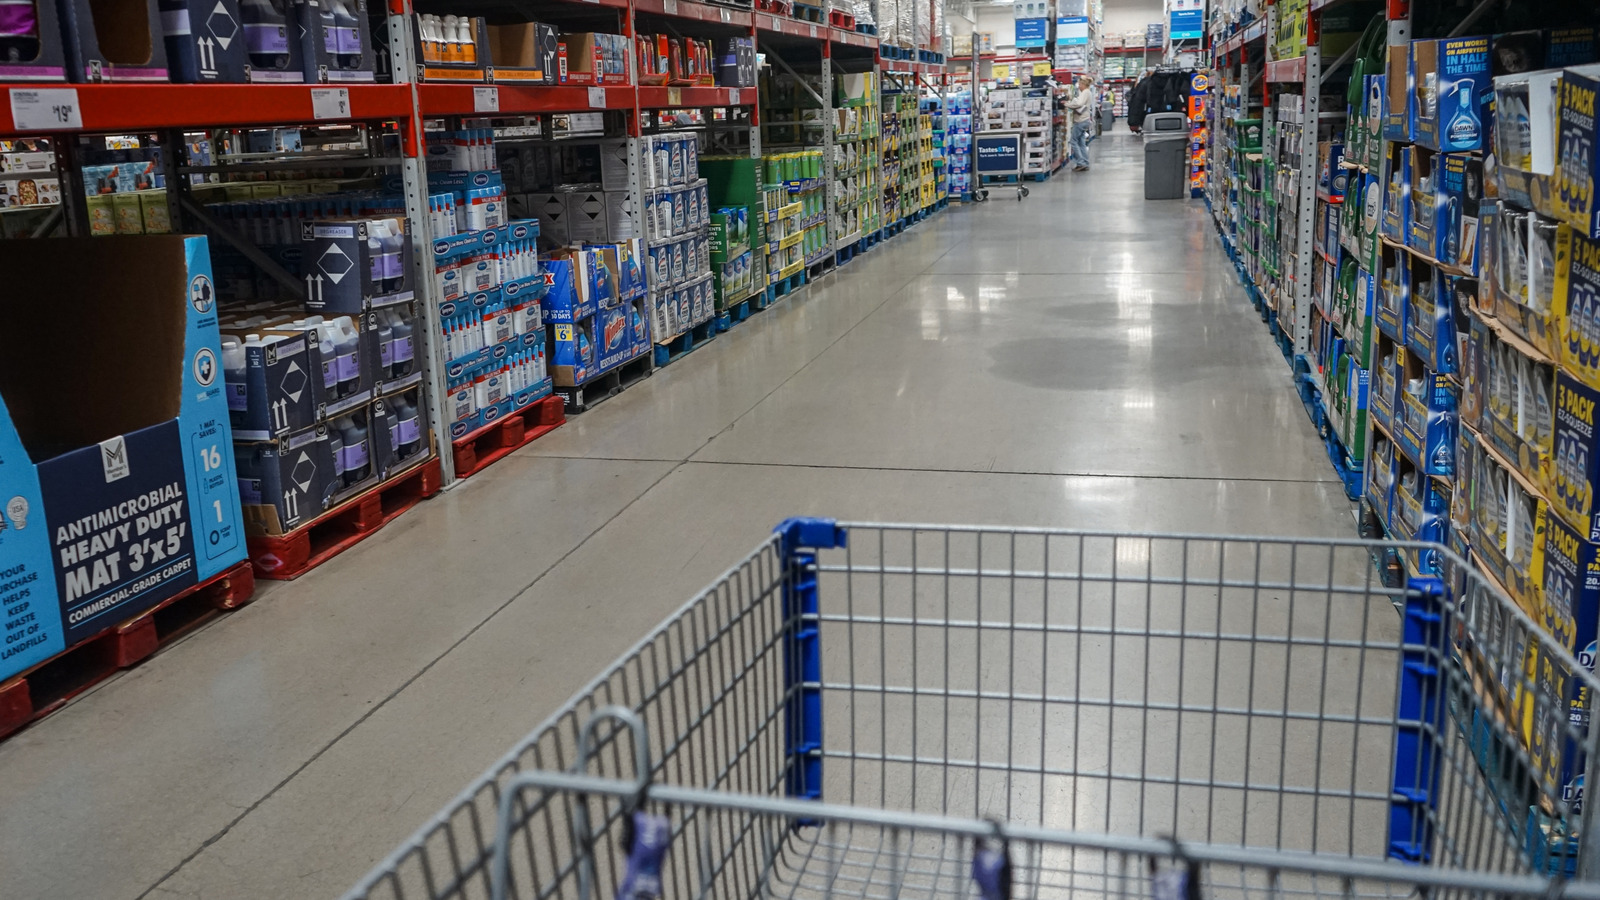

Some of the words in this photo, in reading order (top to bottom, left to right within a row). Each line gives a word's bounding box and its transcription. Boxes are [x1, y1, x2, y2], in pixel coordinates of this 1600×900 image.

[1456, 46, 1488, 55] AIRFRYERS
[1464, 39, 1488, 48] WORKS
[1446, 55, 1458, 65] IN
[1460, 52, 1488, 64] HALF
[1446, 65, 1463, 74] THE
[1464, 63, 1487, 73] TIME
[1564, 82, 1570, 106] 3
[1571, 84, 1596, 117] PACK
[1574, 237, 1581, 261] 3
[1582, 241, 1600, 272] PAC
[1573, 261, 1600, 288] EZ-SQUEE
[604, 316, 626, 354] Windex
[1559, 384, 1565, 408] 3
[1566, 389, 1595, 426] PACK
[199, 428, 217, 439] SAVES:
[204, 420, 215, 428] MAT
[1558, 408, 1592, 438] EZ-SQUEEZE
[200, 445, 221, 472] 16
[56, 481, 182, 546] ANTIMICROBIAL
[213, 500, 223, 522] 1
[60, 522, 131, 568] HEAVY
[136, 500, 183, 536] DUTY
[1548, 518, 1554, 541] 3
[1554, 524, 1580, 564] PACK
[0, 564, 25, 580] YOUR
[65, 551, 121, 603] MAT
[1587, 563, 1600, 571] PA
[0, 572, 38, 594] URCHASE
[68, 572, 162, 624] COMMERCIAL-GRADE
[162, 557, 192, 580] CARPET
[3, 588, 31, 606] HELPS
[8, 602, 30, 617] KEEP
[5, 612, 36, 631] WASTE
[6, 630, 25, 644] OUT
[27, 623, 39, 635] OF
[1, 633, 47, 660] LANDFILLS
